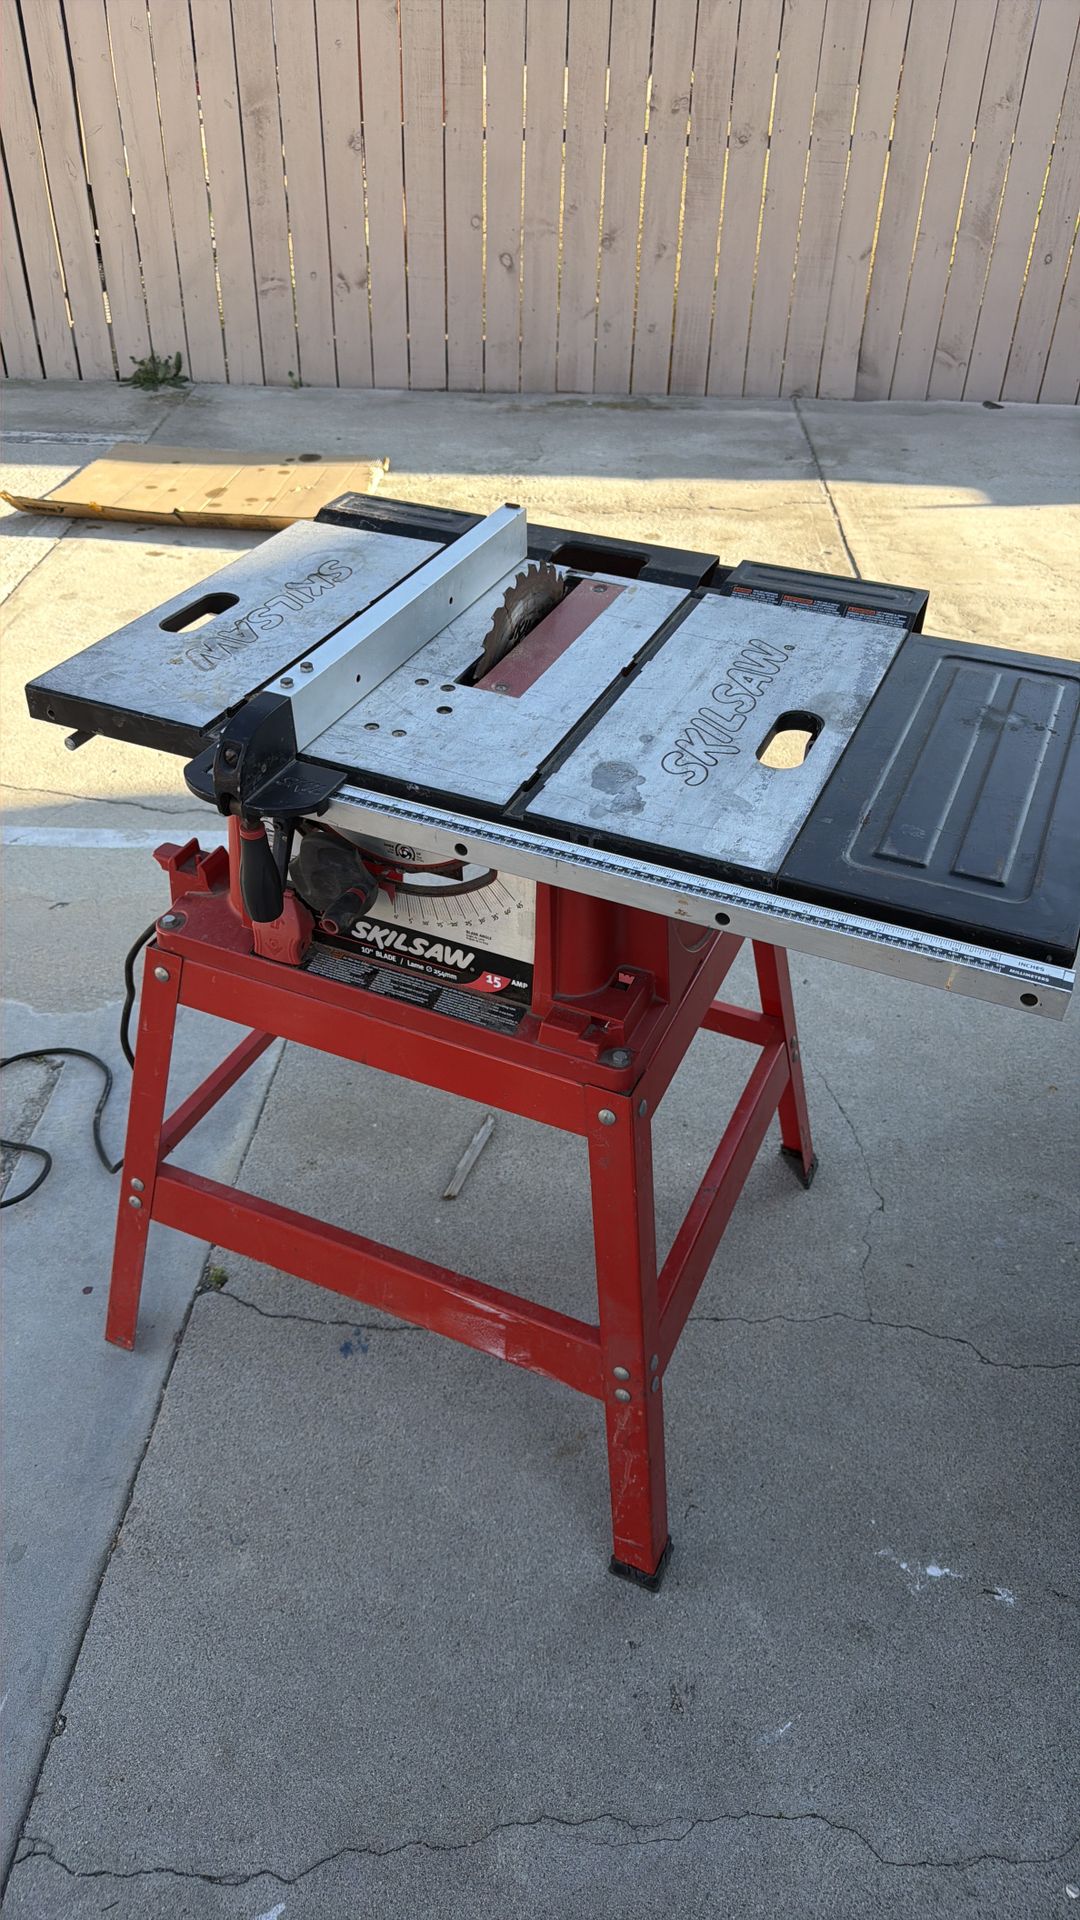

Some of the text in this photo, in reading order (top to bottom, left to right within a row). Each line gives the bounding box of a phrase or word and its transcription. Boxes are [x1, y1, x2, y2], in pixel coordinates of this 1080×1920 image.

[186, 559, 353, 672] SKILSAW
[661, 638, 789, 787] SKILSAW
[351, 921, 476, 969] SKILSAW
[375, 950, 397, 962] BLADE
[407, 959, 424, 971] Lame
[1018, 961, 1045, 972] INCHES
[485, 974, 529, 989] 15 AMP
[1009, 968, 1050, 983] MILLIMETERS
